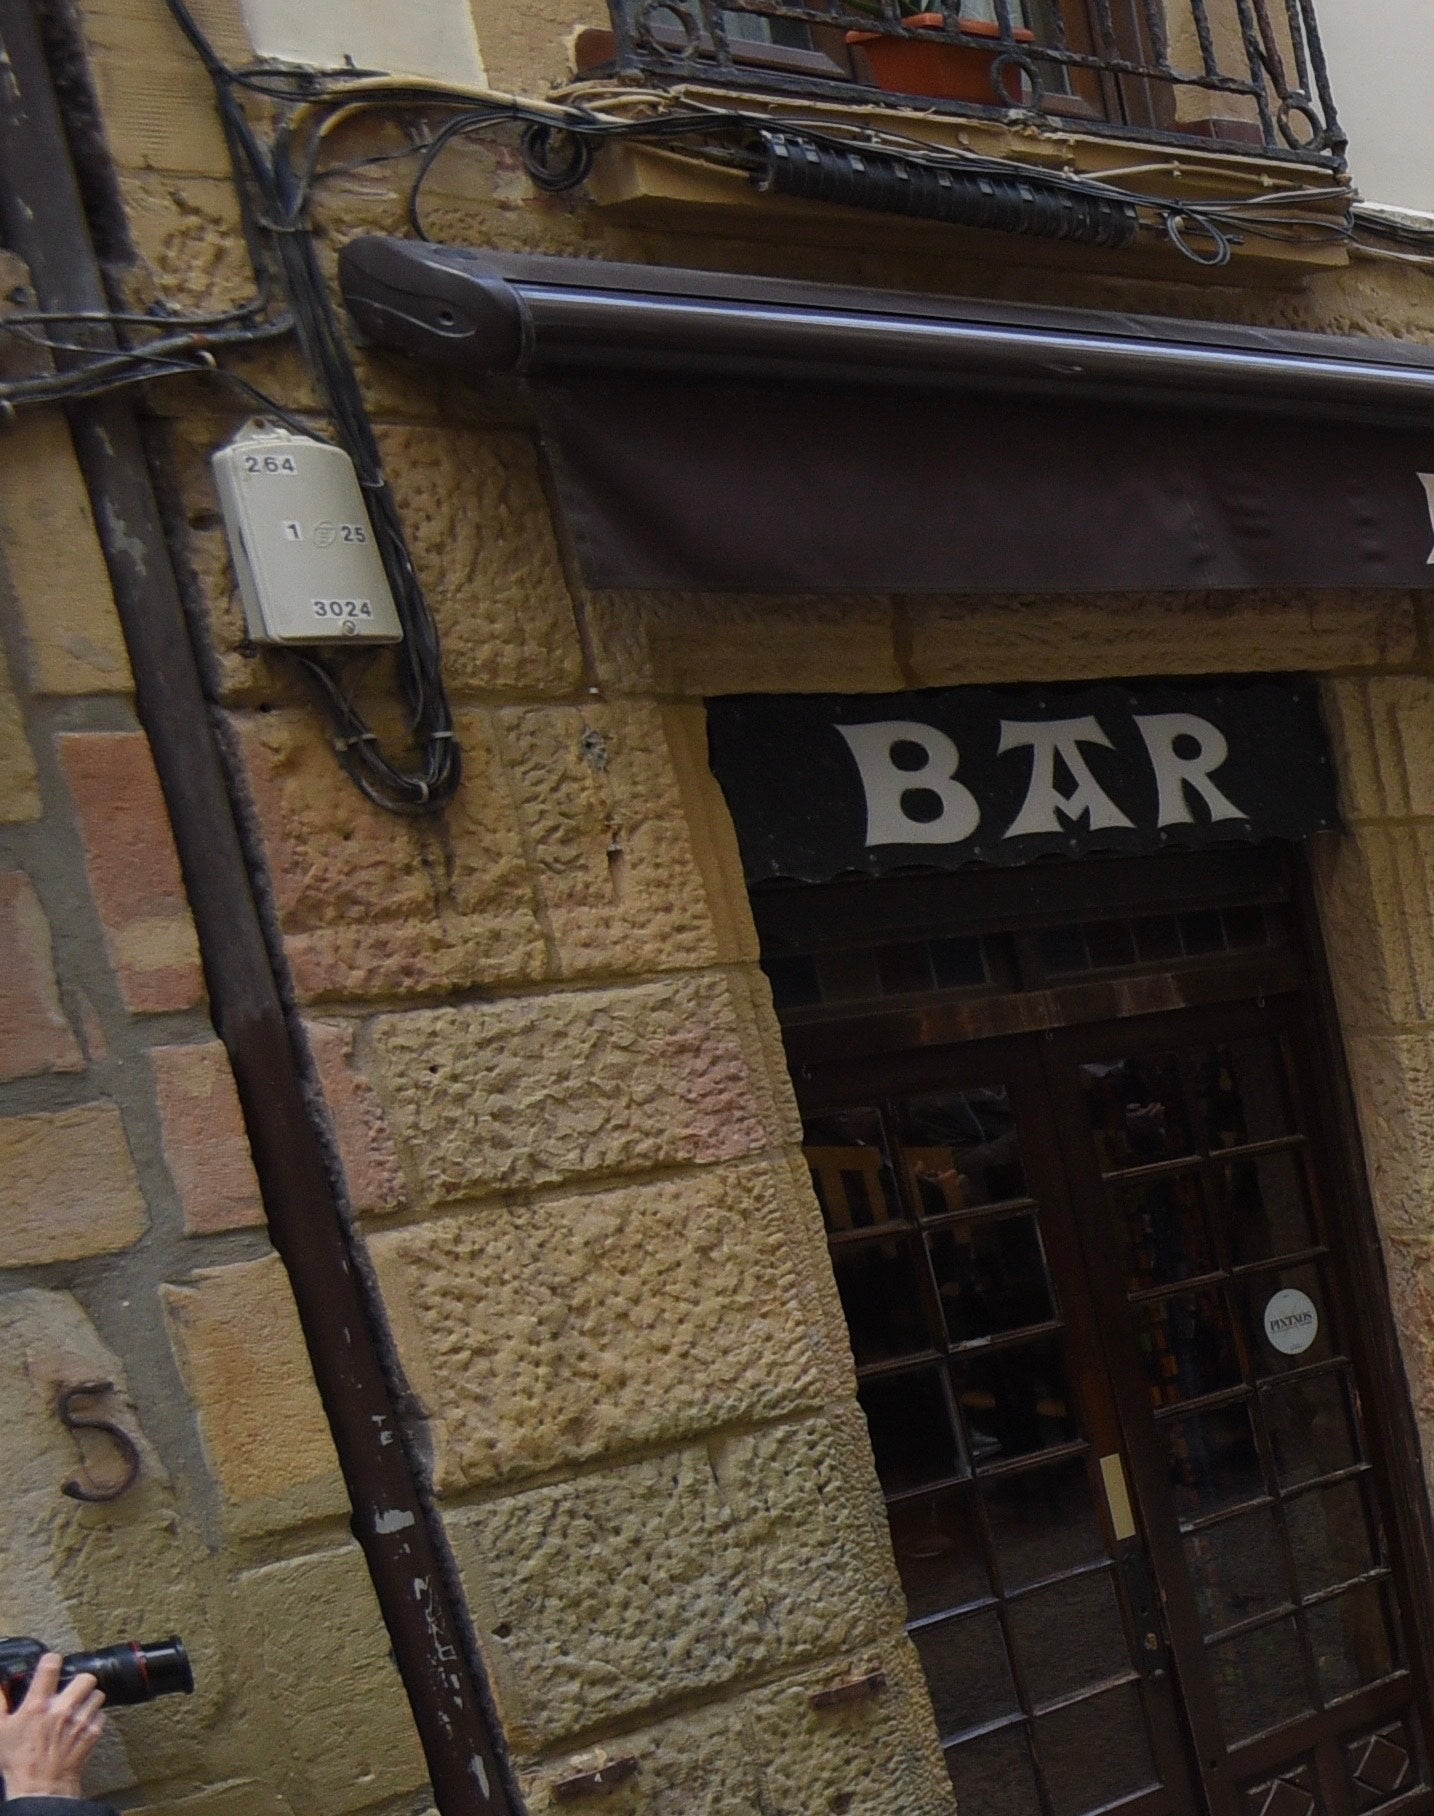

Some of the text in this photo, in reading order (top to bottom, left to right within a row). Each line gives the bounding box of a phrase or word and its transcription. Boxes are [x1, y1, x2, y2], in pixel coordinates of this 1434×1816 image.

[245, 456, 295, 473] 264
[288, 523, 367, 543] 1 25
[314, 601, 372, 617] 3024
[834, 712, 1250, 848] BAR
